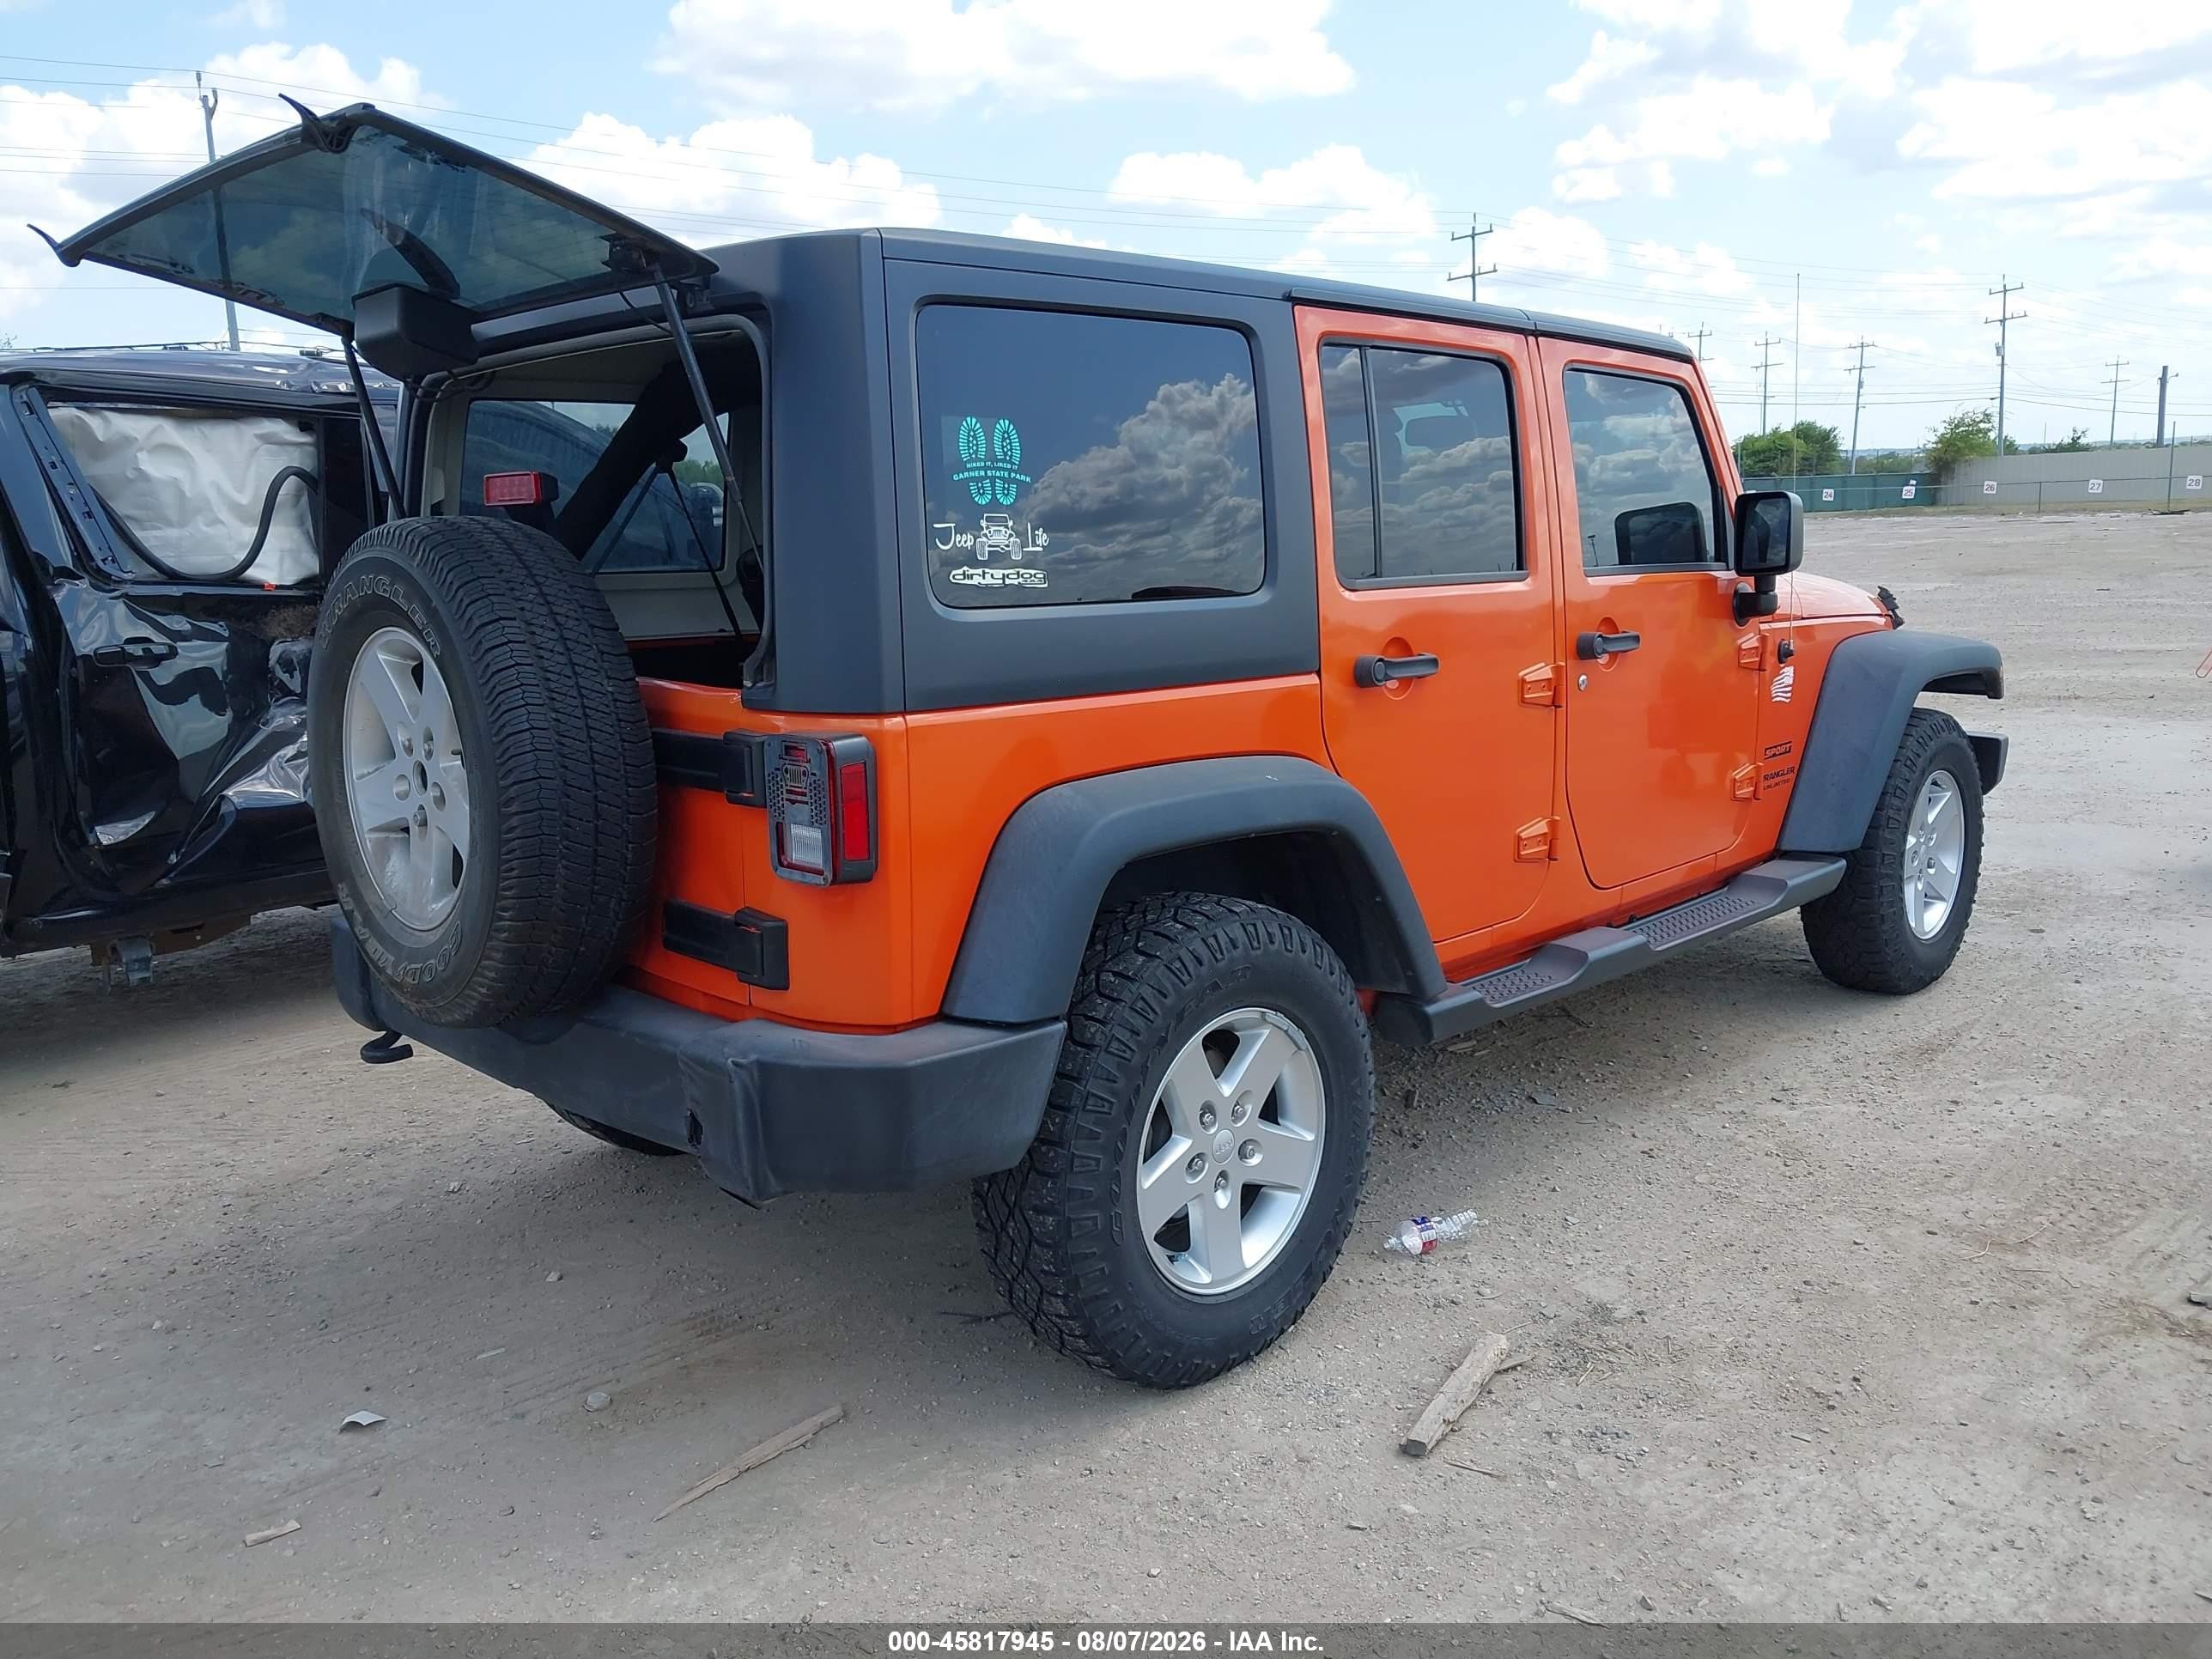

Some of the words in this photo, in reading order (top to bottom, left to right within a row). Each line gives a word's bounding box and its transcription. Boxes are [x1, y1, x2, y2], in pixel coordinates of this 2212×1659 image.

[953, 471, 985, 481] GARNER
[1010, 472, 1031, 483] PARK
[2188, 478, 2201, 487] 28
[1984, 483, 1996, 492] 26
[933, 523, 975, 550] Jeep
[1023, 522, 1049, 551] Life
[951, 569, 1047, 586] dirtydog
[319, 575, 441, 659] WRANGLER
[1765, 744, 1792, 757] SPORT
